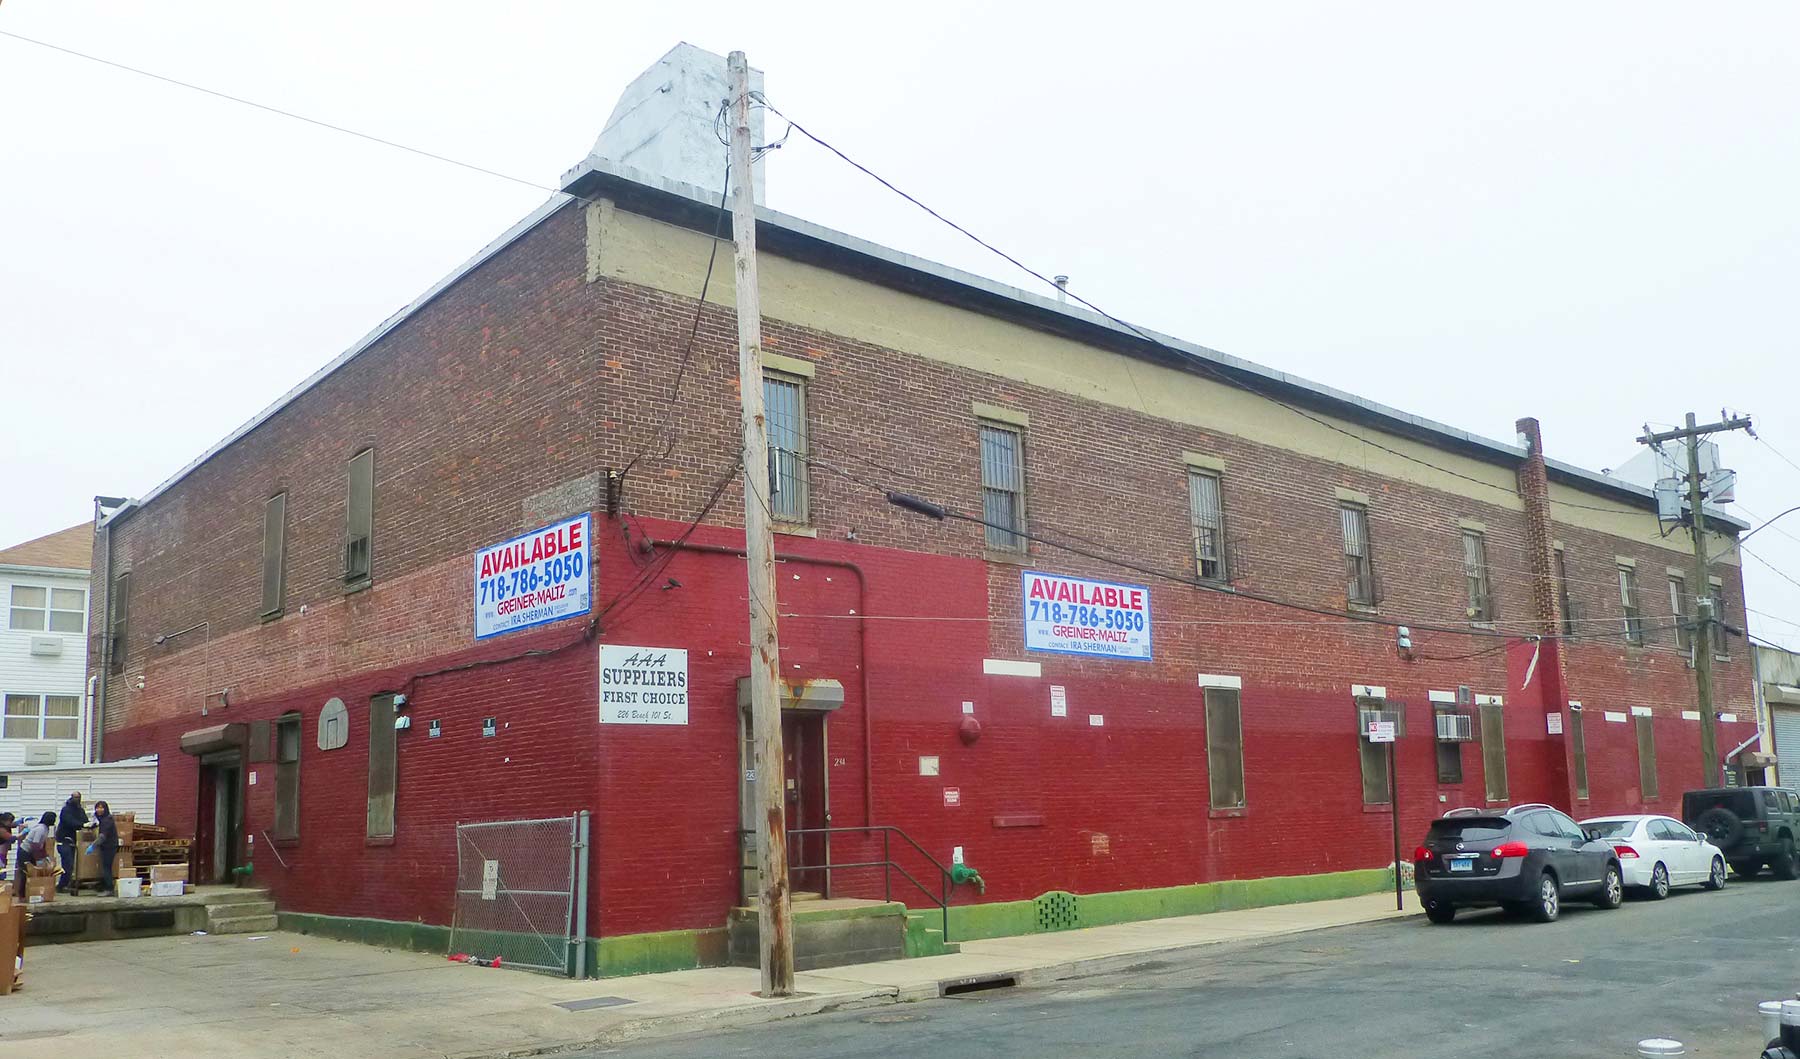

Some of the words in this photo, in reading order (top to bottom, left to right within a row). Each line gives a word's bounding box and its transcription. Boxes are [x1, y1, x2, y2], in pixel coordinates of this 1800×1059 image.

[480, 522, 582, 579] AVAILABLE
[480, 551, 584, 606] 718-786-5050
[497, 583, 566, 616] GREINER-MALTZ
[1029, 578, 1143, 611] AVAILABLE
[510, 614, 521, 626] IRA
[522, 605, 554, 623] SHERMAN
[1029, 600, 1144, 632] 718-786-5050
[1052, 625, 1128, 643] GREINER-MALTZ
[1070, 641, 1082, 650] IRA
[1083, 641, 1117, 653] SHERMAN
[622, 652, 667, 668] AAA
[603, 667, 686, 688] SUPPLIERS
[603, 690, 638, 703] FIRST
[642, 692, 686, 705] CHOICE
[617, 709, 629, 719] 226
[631, 709, 650, 719] Beach
